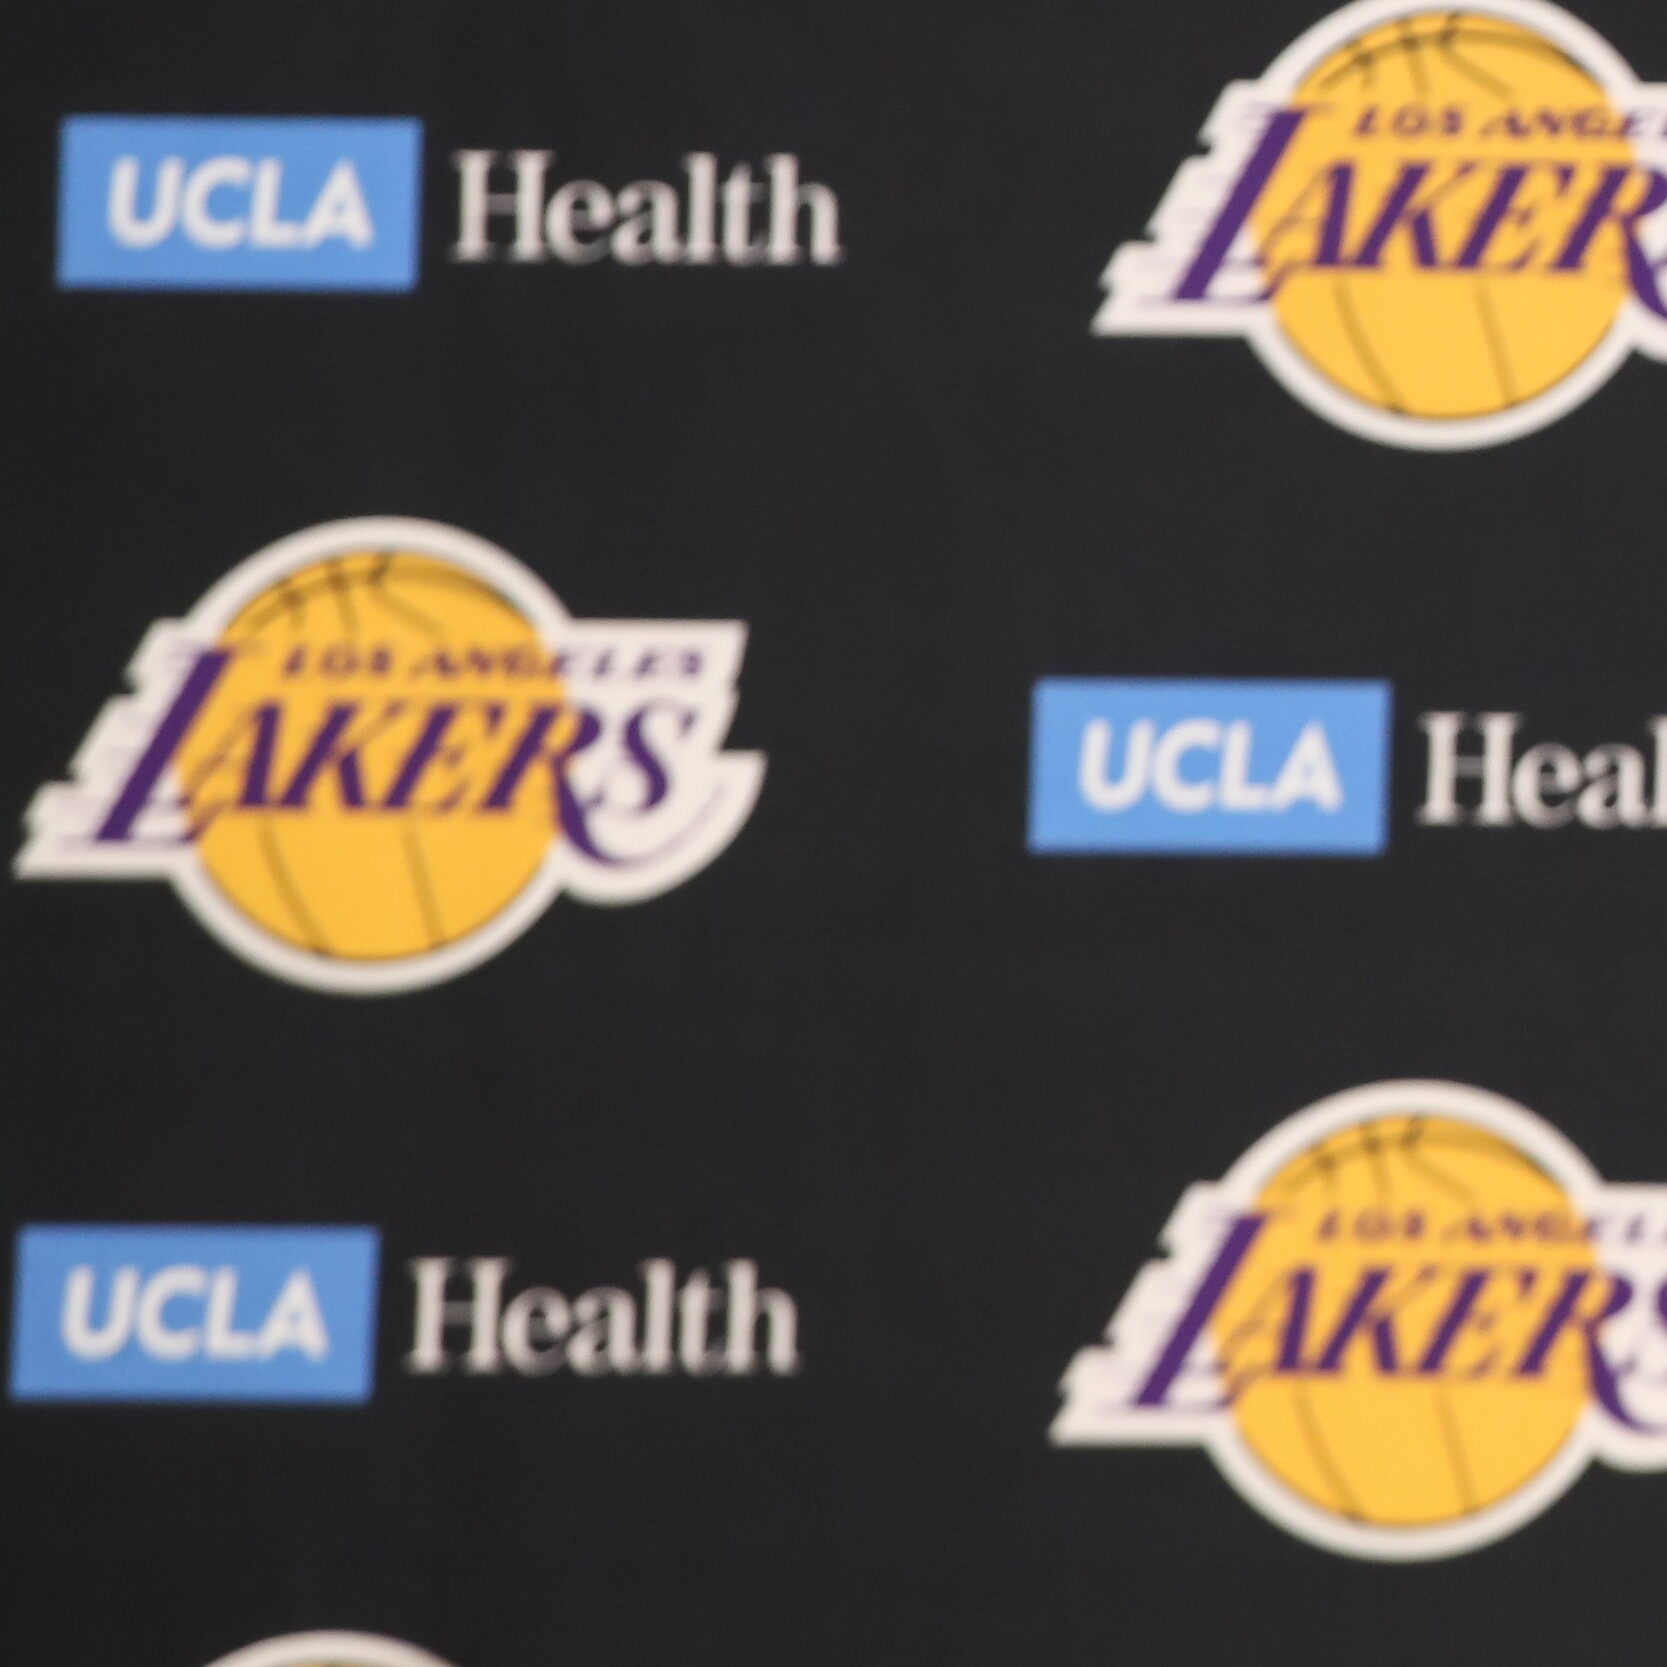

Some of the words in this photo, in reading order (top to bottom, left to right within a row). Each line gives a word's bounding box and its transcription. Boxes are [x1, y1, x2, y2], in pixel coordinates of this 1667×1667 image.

[1352, 104, 1465, 138] LOS
[108, 156, 374, 249] UCLA
[456, 150, 840, 265] Health
[280, 643, 394, 677] LOS
[408, 642, 711, 679] ANGELES
[71, 642, 728, 870] LAKERS
[1078, 717, 1344, 814] UCLA
[1314, 1208, 1428, 1242] LOS
[62, 1265, 329, 1360] UCLA
[410, 1258, 797, 1374] Health
